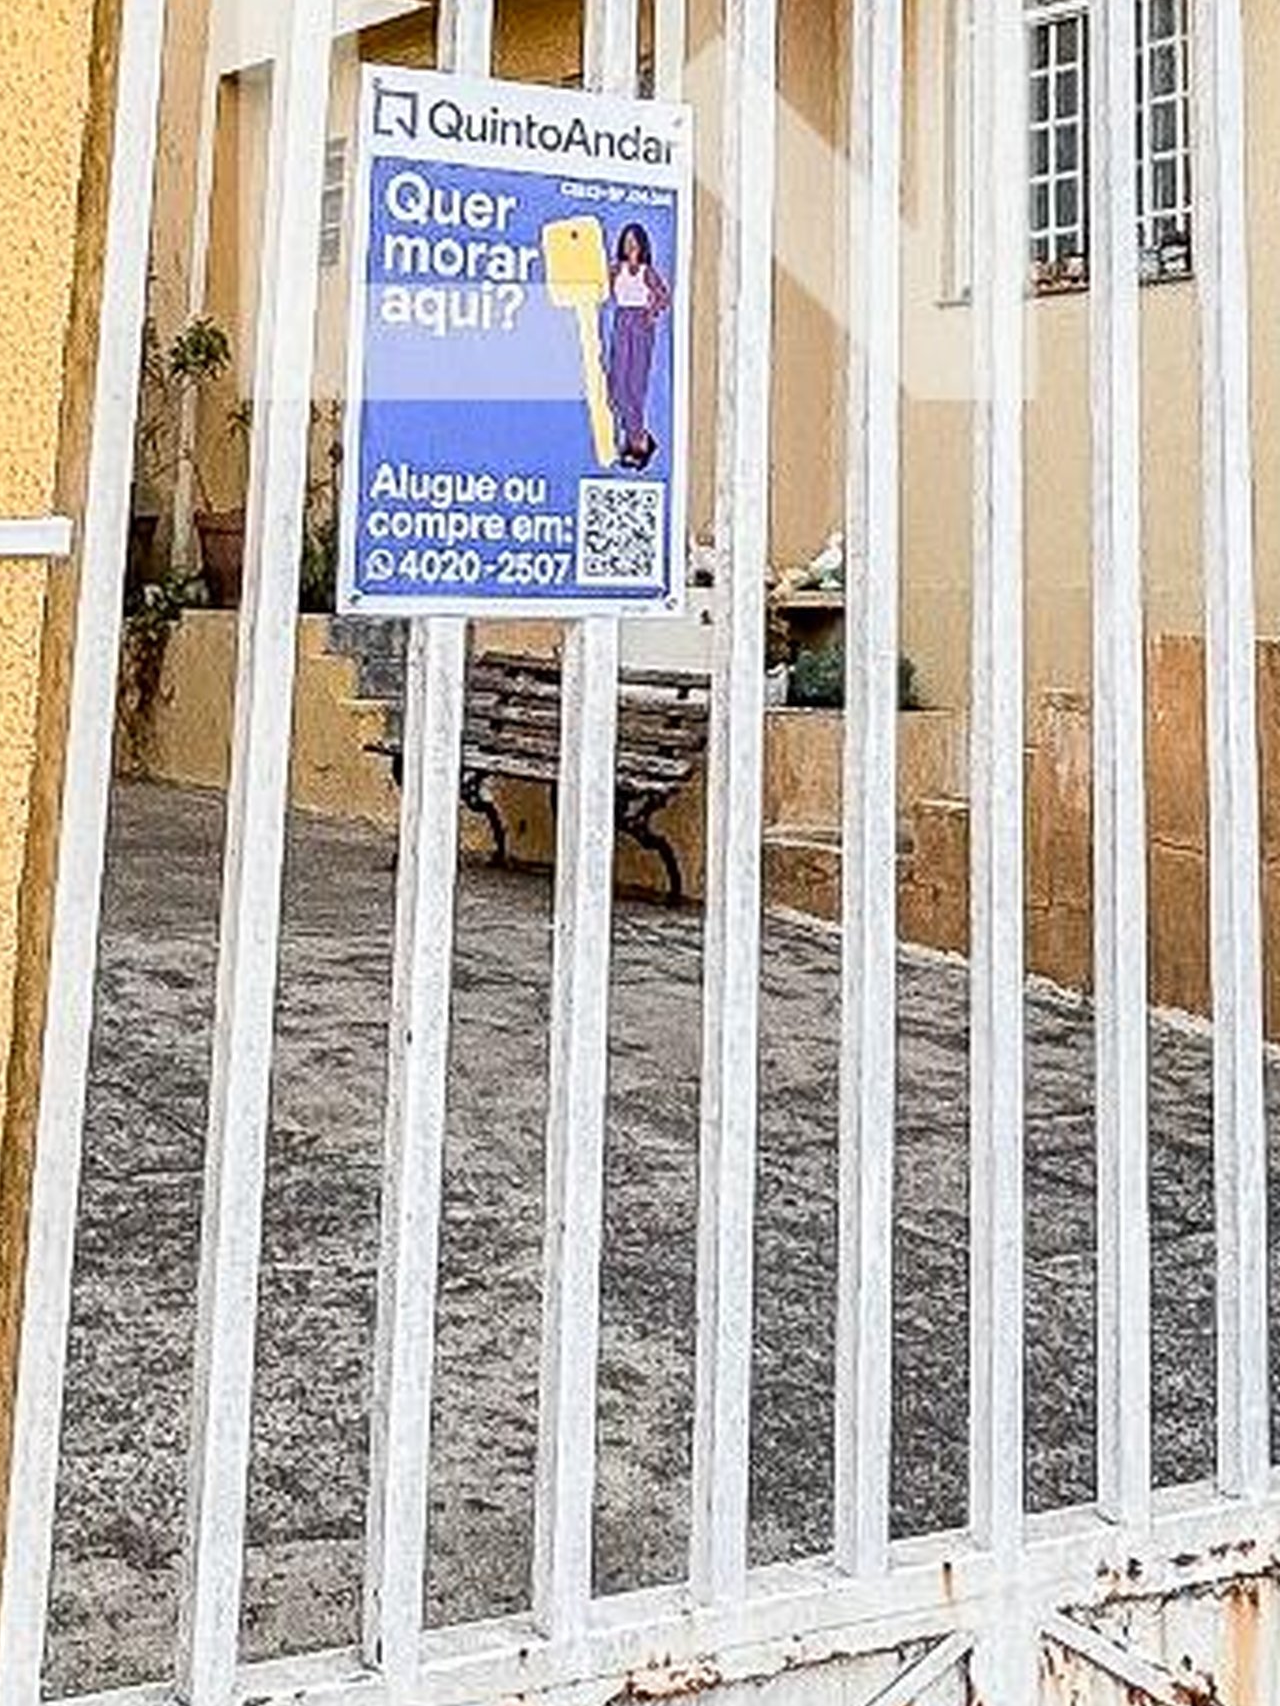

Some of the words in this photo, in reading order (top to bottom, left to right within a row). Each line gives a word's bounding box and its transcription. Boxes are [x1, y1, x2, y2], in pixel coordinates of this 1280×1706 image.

[428, 100, 676, 165] QuintoAndar
[386, 171, 518, 231] Quer
[384, 233, 540, 282] morar
[381, 280, 525, 336] aqui?
[371, 463, 497, 508] Alugue
[504, 474, 546, 502] ou
[368, 511, 504, 544] compre
[511, 514, 574, 541] em:
[399, 550, 572, 584] 4020-2507
